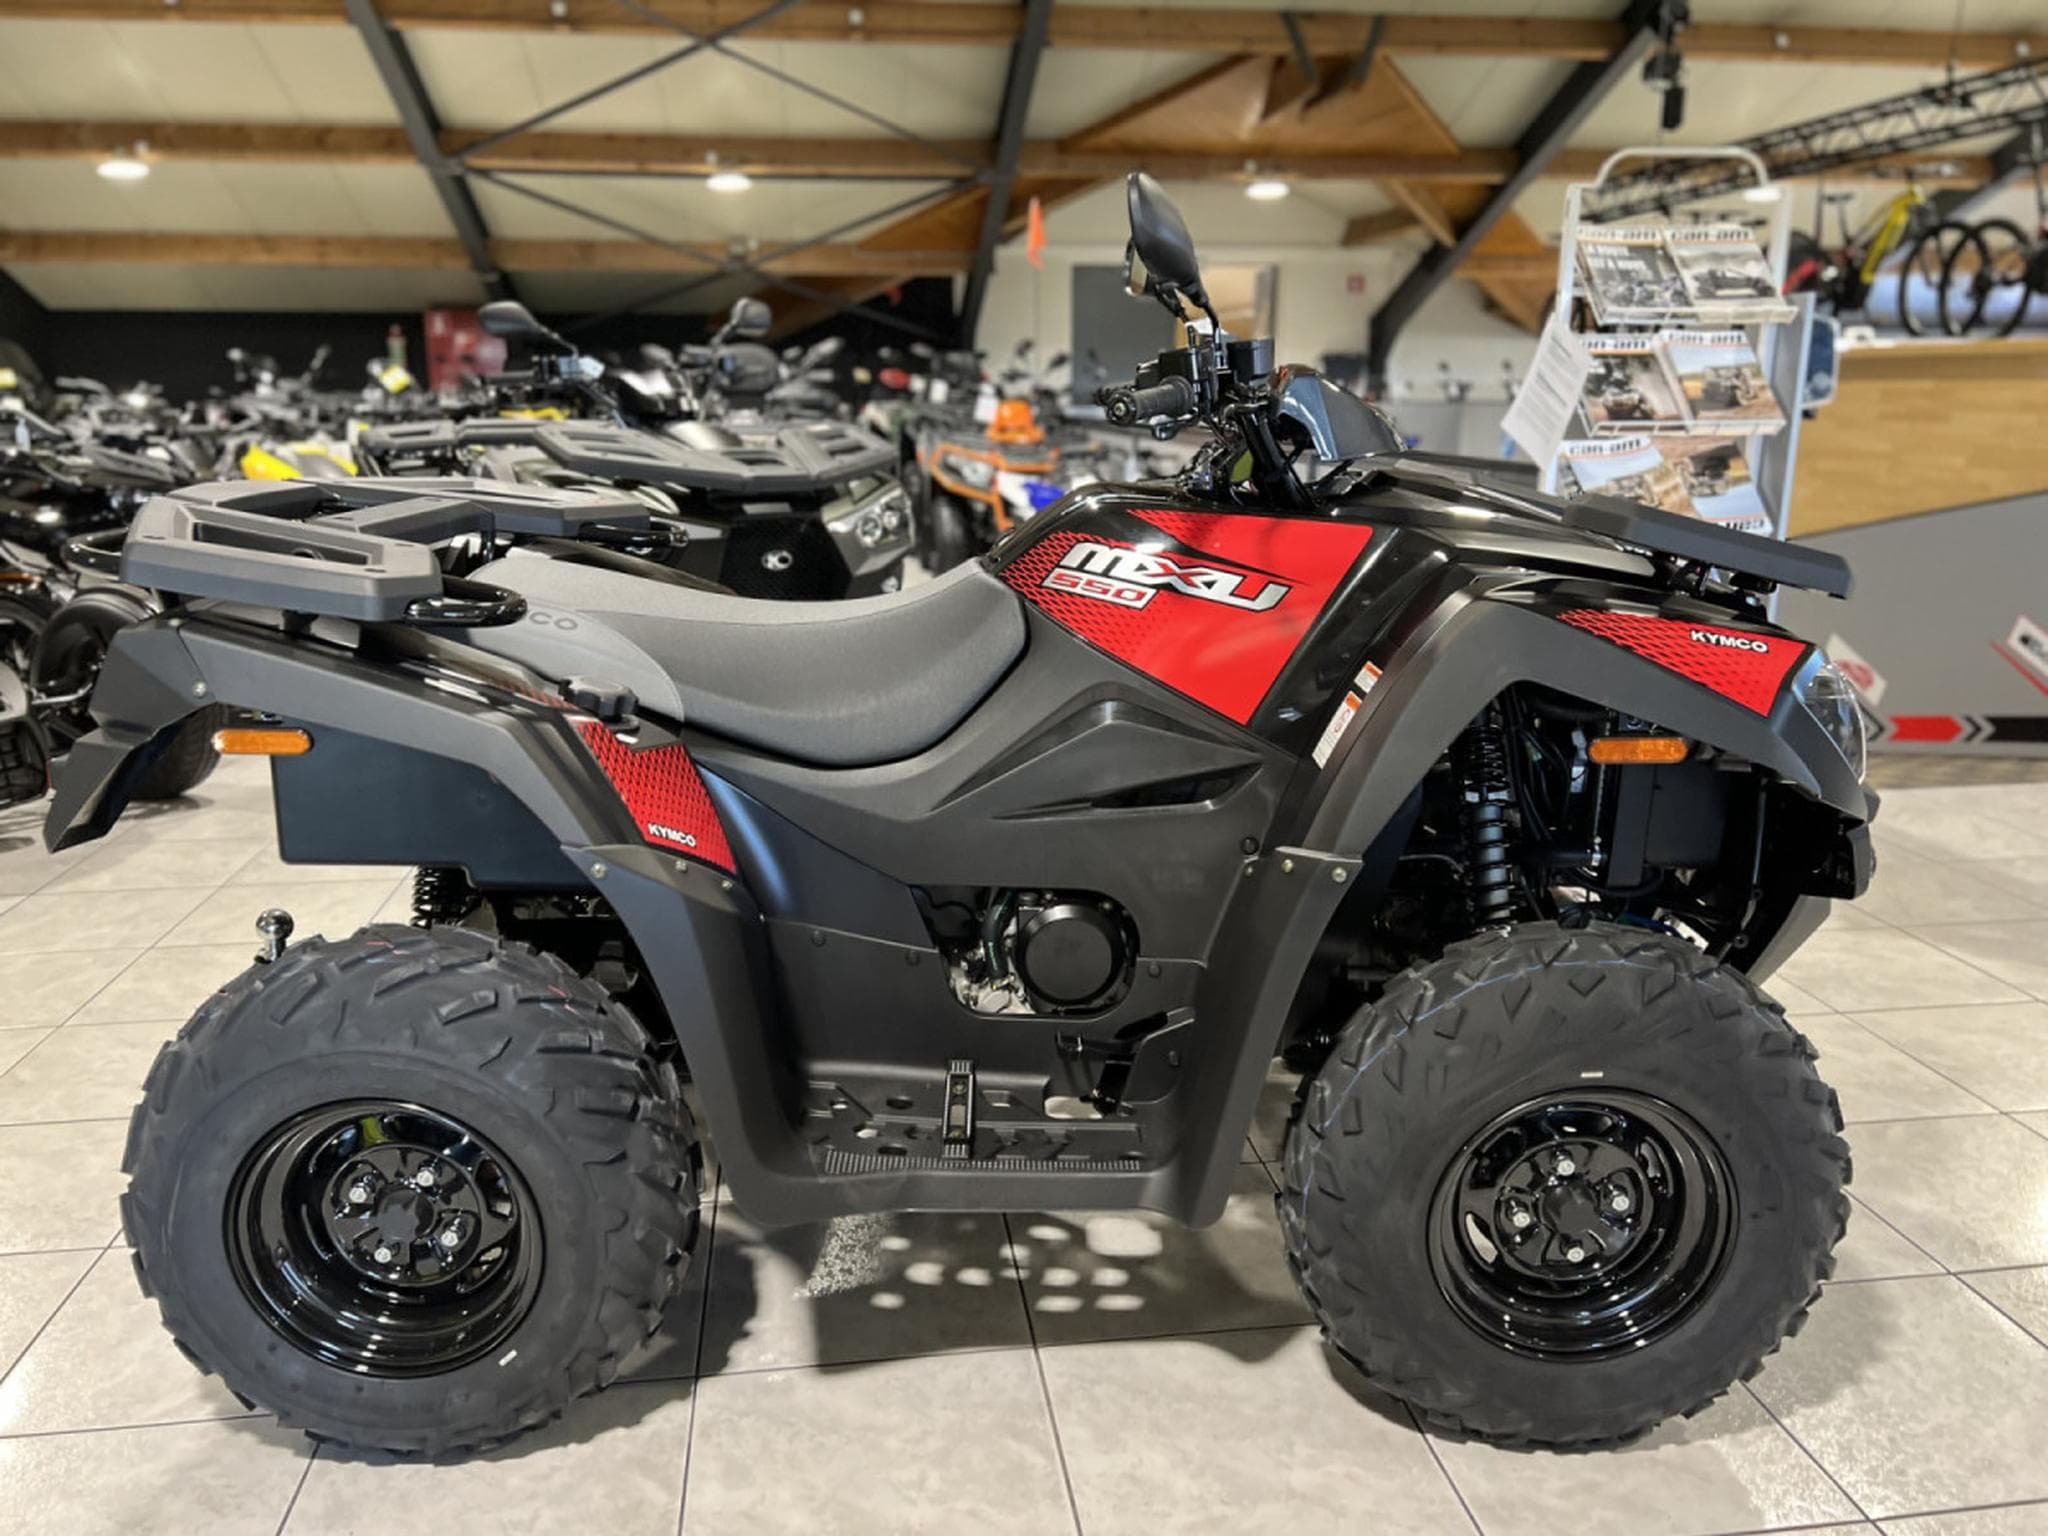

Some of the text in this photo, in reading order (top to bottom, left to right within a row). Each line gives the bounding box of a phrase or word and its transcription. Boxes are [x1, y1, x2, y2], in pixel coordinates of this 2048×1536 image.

[1050, 571, 1147, 602] 550
[1690, 629, 1769, 654] KYMCO
[647, 822, 698, 848] KYMCO
